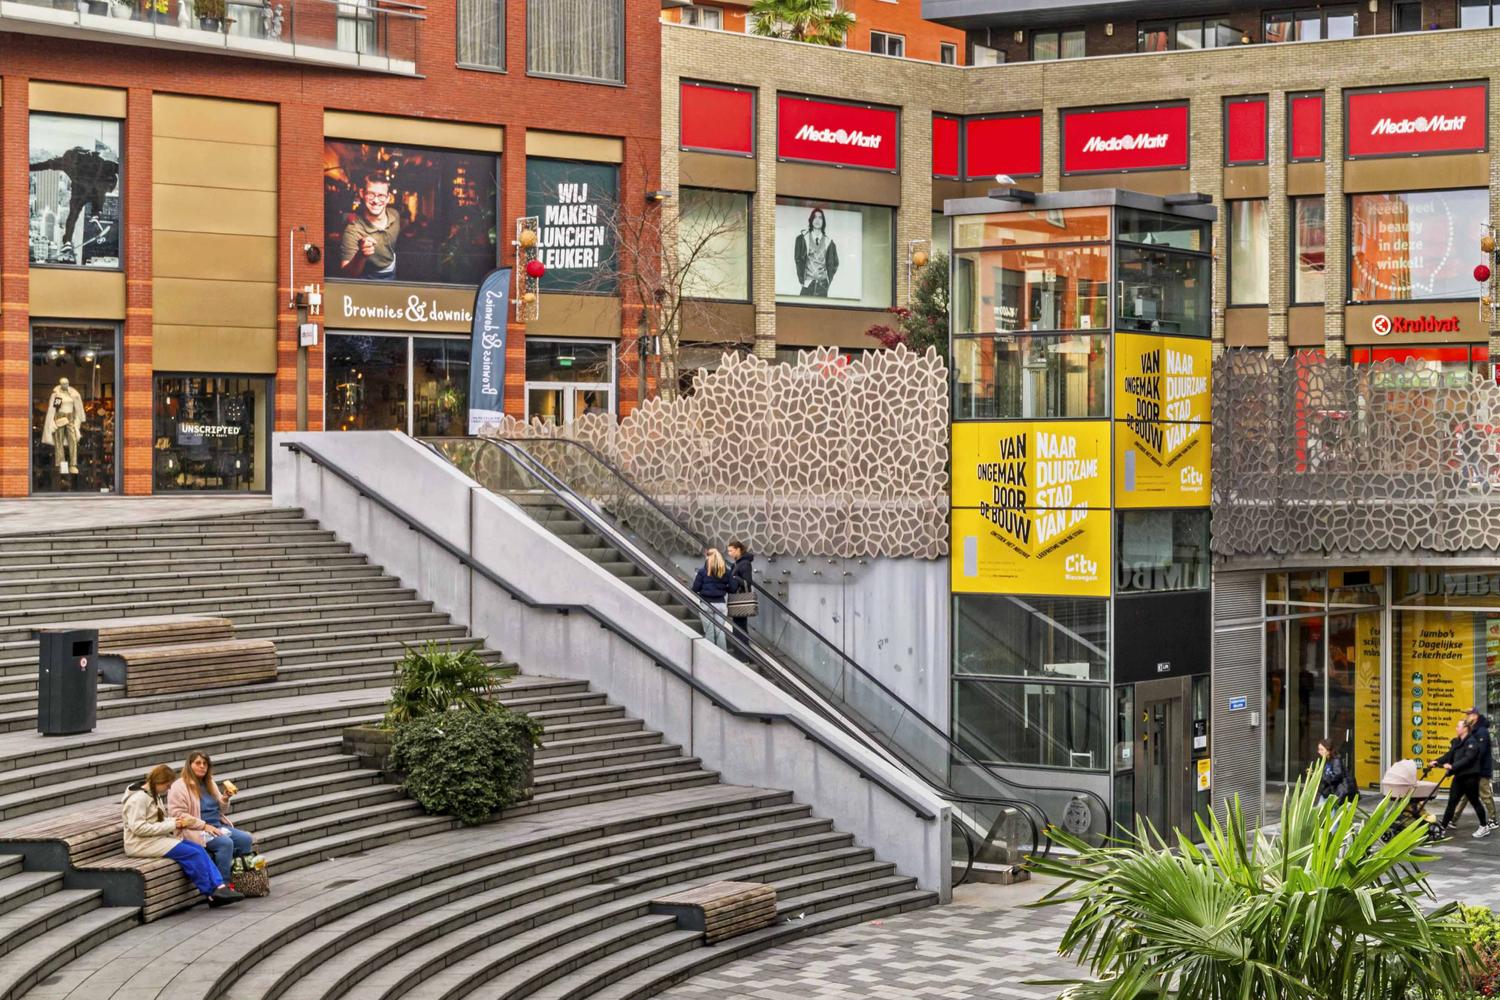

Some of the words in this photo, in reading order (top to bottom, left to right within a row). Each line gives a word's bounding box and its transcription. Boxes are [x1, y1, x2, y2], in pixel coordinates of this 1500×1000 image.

[558, 183, 588, 203] WIJ
[545, 204, 598, 225] MAKEN
[537, 226, 605, 248] LUNCHEN
[1378, 221, 1424, 234] beauty
[1379, 239, 1391, 251] in
[1393, 239, 1423, 251] deze
[539, 248, 599, 269] LEUKER!
[343, 295, 404, 319] Brownies
[405, 295, 429, 322] &
[429, 304, 473, 322] downie
[1393, 315, 1460, 333] Kruidvat
[1140, 349, 1160, 375] VAN
[1166, 349, 1193, 375] NAAR
[1125, 376, 1161, 400] ONGEMAK
[1166, 376, 1207, 401] DUURZAME
[1136, 397, 1160, 425] DOOR
[1166, 399, 1191, 426] STAD
[181, 422, 240, 435] UNSCRIPTED
[1135, 418, 1163, 454] BOUW
[1166, 423, 1187, 453] VAN
[1000, 433, 1027, 460] VAN
[1036, 431, 1076, 459] NAAR
[977, 461, 1027, 487] ONGEMAK
[1036, 459, 1098, 488] DUURZAME
[1180, 466, 1203, 486] City
[993, 485, 1027, 514] DOOR
[1036, 484, 1073, 516] STAD
[980, 501, 990, 520] DE
[991, 506, 1032, 545] BOUW
[1036, 508, 1066, 545] VAN
[1068, 501, 1088, 528] JOU
[1064, 553, 1098, 575] City
[1419, 629, 1455, 638] Jumbo's
[1411, 640, 1417, 649] 7
[1418, 639, 1463, 651] Dagelijkse
[1411, 650, 1463, 660] Zekerheden
